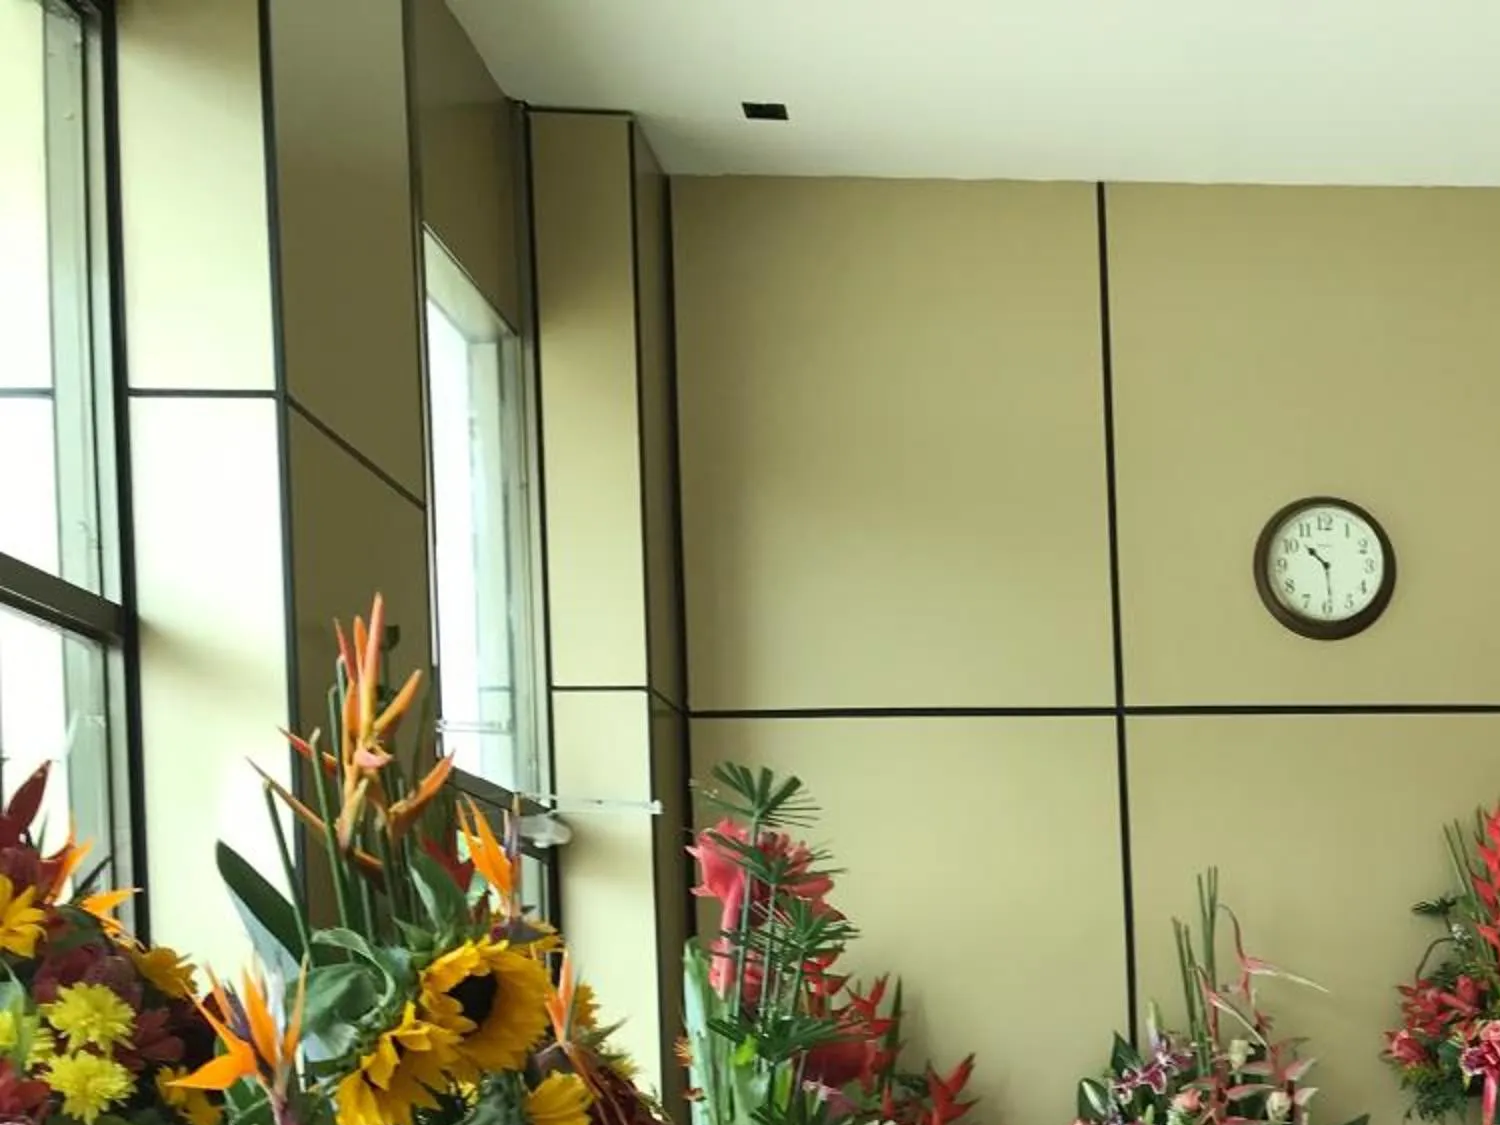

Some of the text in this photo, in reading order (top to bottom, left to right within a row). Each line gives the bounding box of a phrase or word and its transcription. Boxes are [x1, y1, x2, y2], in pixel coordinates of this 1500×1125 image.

[1317, 513, 1333, 531] 12
[1299, 523, 1311, 538] 11
[1283, 538, 1299, 554] 10
